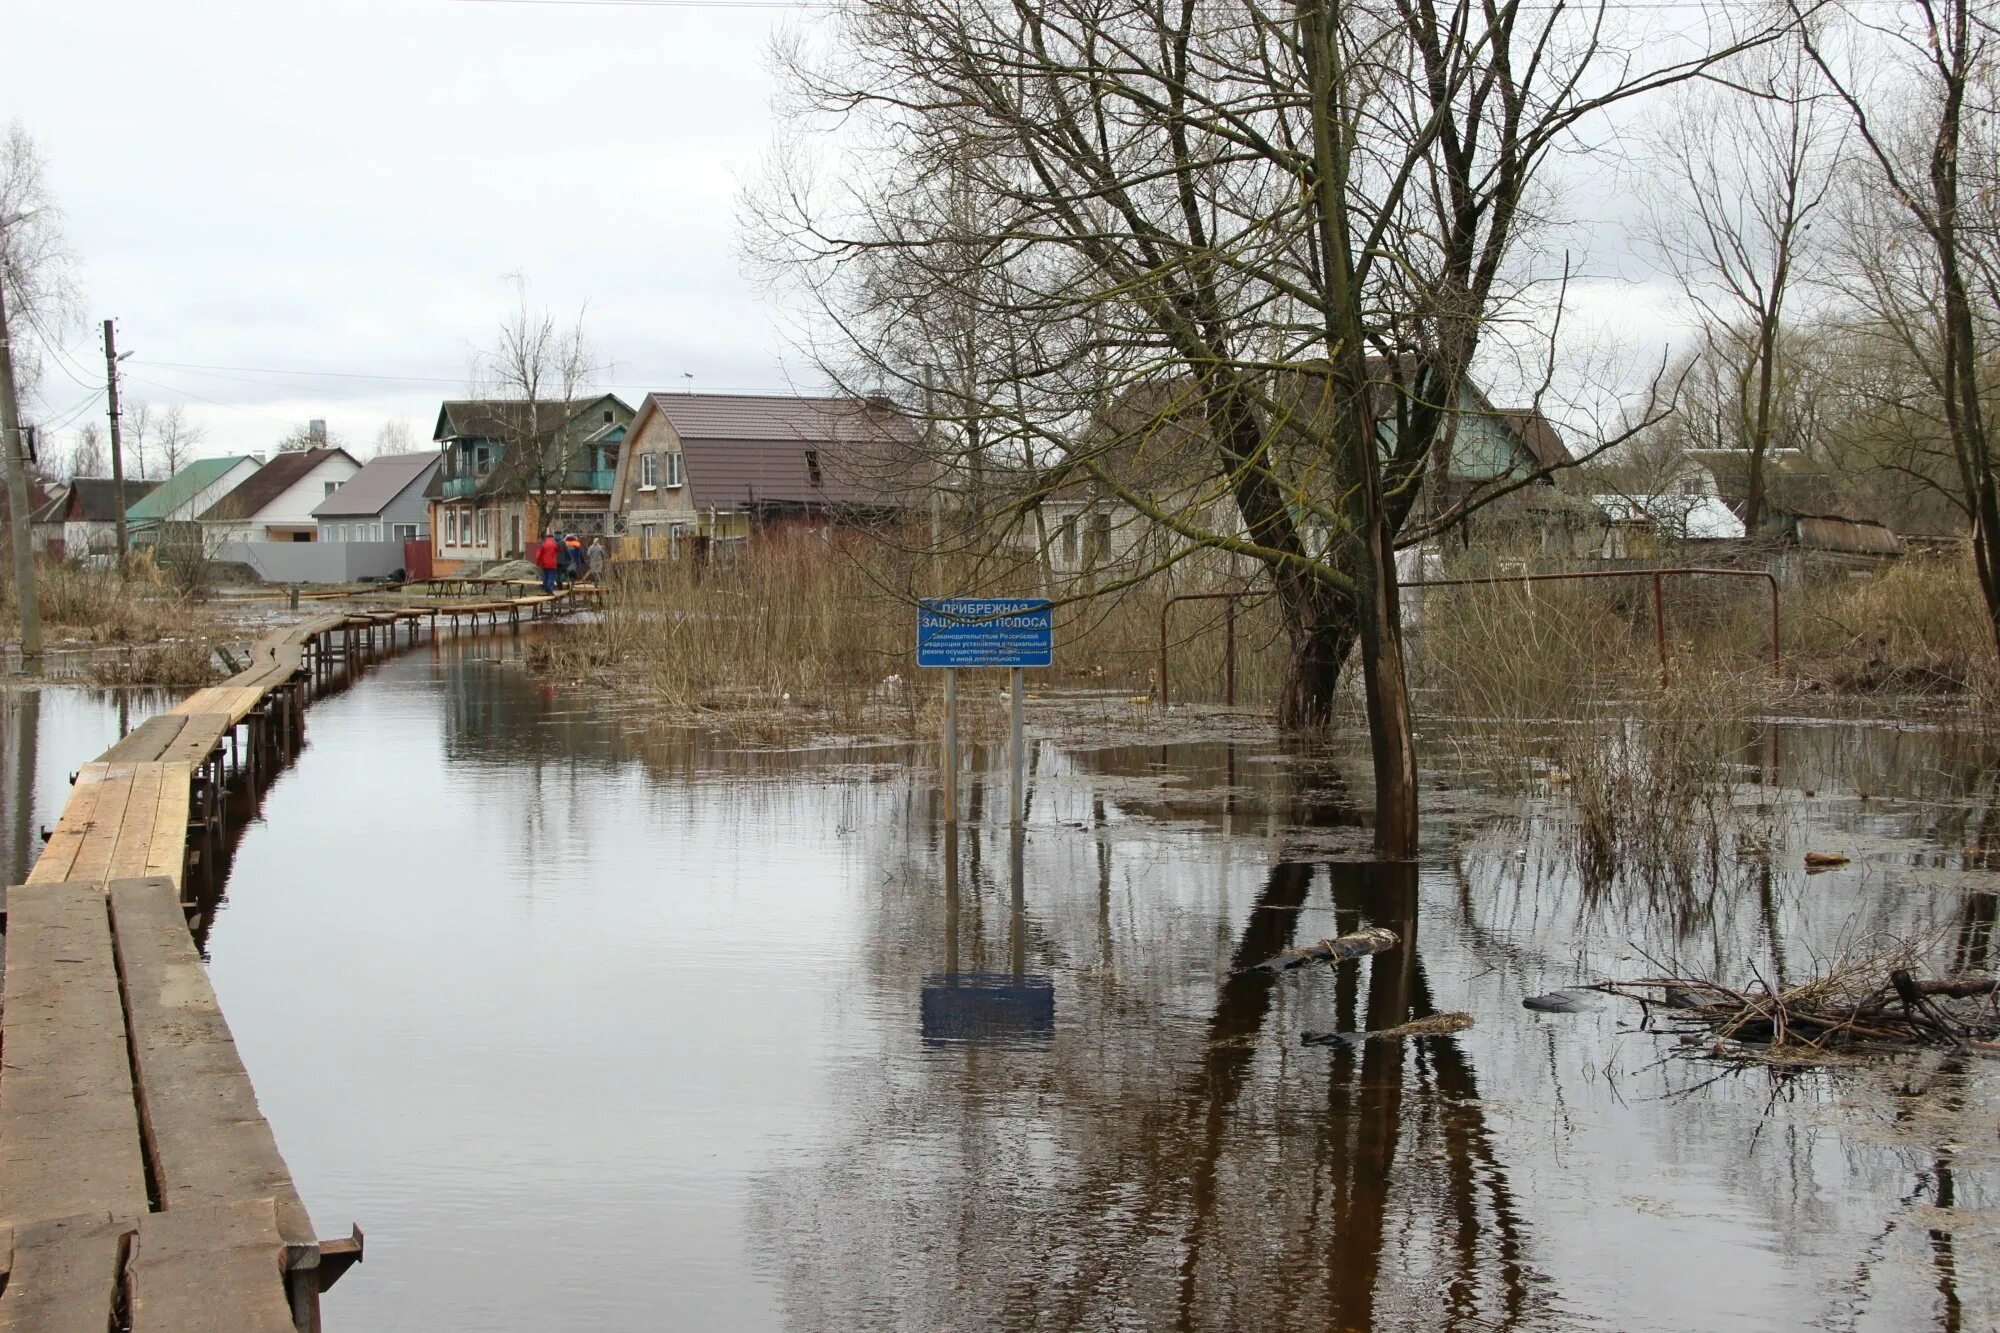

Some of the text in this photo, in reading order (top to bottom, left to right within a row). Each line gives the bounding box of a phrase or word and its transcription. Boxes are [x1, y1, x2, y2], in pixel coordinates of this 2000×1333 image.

[942, 603, 1028, 615] ПРИБРЕЖНАЯ
[996, 617, 1048, 628] ПОЛОСА
[932, 633, 998, 641] аконодательством
